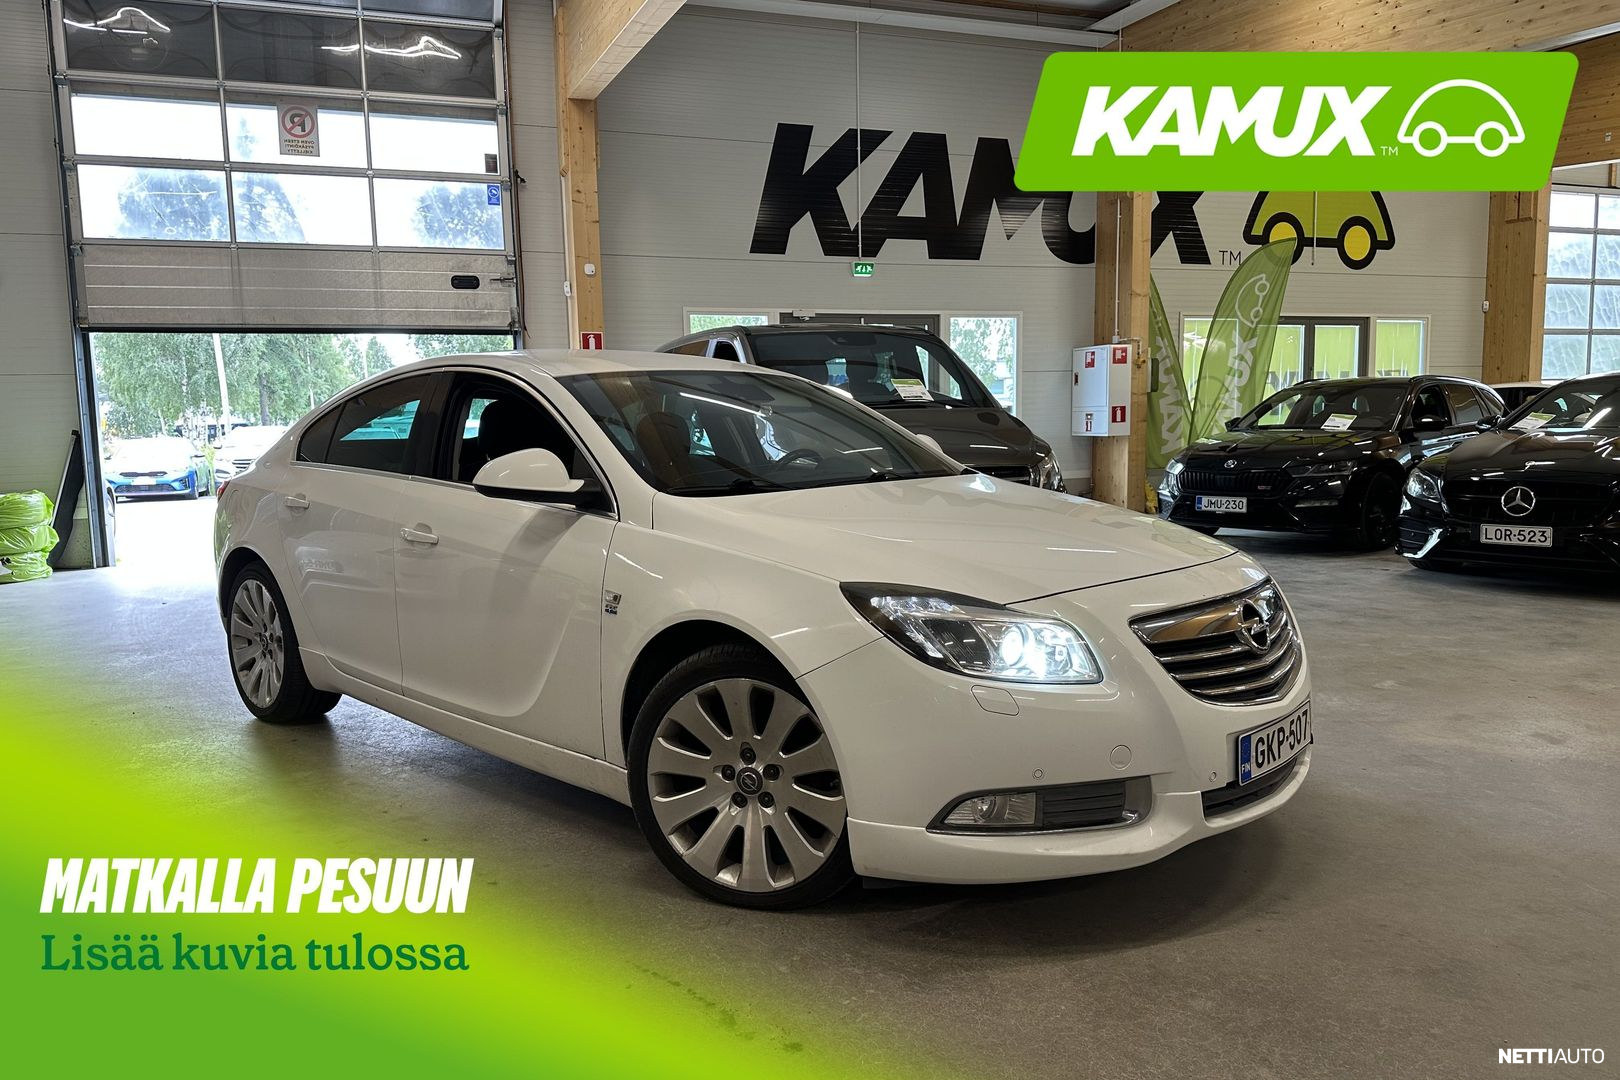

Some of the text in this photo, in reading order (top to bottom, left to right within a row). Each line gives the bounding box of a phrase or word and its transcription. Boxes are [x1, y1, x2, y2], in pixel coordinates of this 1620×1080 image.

[1219, 250, 1241, 266] TM
[1211, 330, 1258, 436] AMUX
[1204, 499, 1244, 510] JMU-230
[1484, 527, 1548, 543] LOR-523
[1241, 708, 1309, 774] FIN GKP-507
